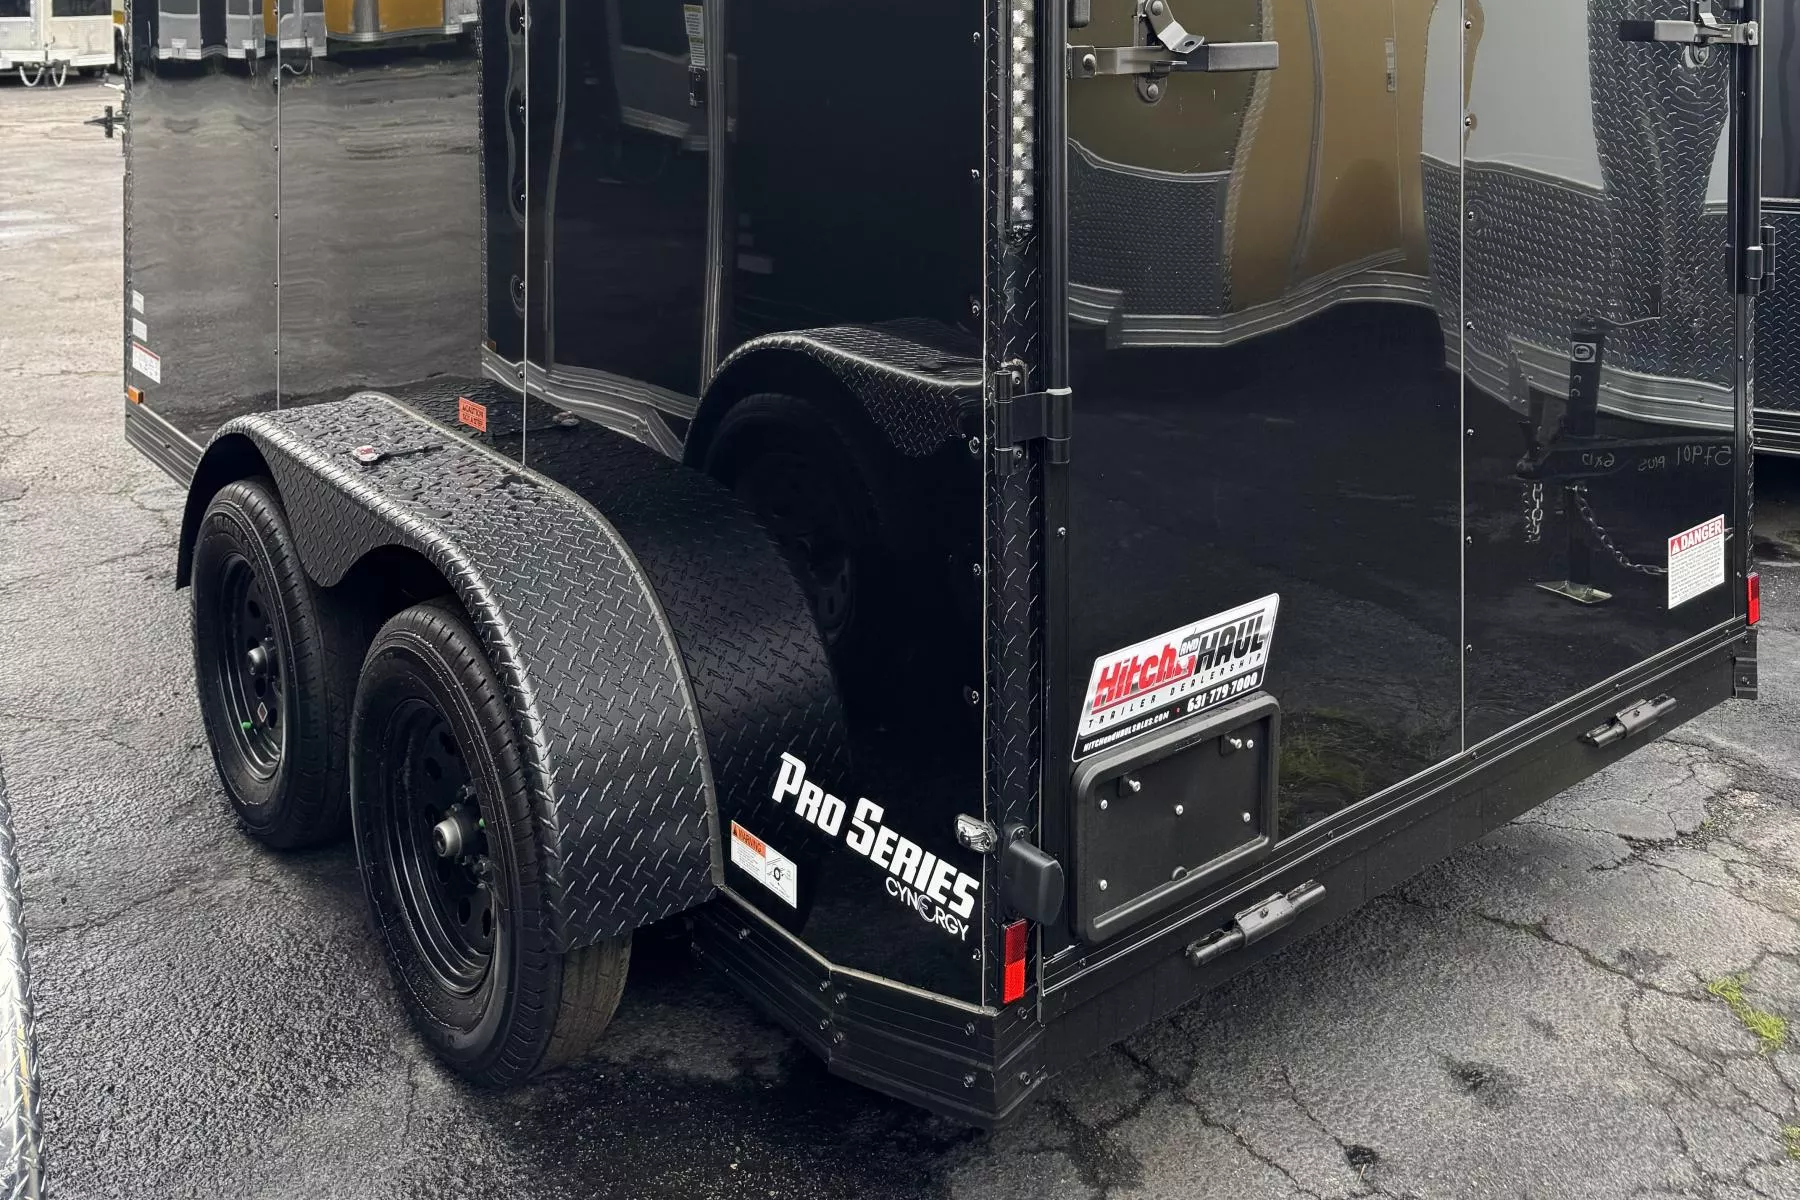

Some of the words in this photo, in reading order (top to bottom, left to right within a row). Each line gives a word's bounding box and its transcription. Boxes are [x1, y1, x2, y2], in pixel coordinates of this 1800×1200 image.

[1680, 519, 1722, 551] DANGER
[1088, 694, 1156, 728] TRAILER
[1170, 653, 1261, 696] DEALERSHIP
[1092, 642, 1177, 708] Hitch
[1179, 638, 1199, 656] AND
[1194, 614, 1265, 675] HAUL
[738, 826, 762, 853] WARNING
[886, 876, 970, 941] CYNERGY
